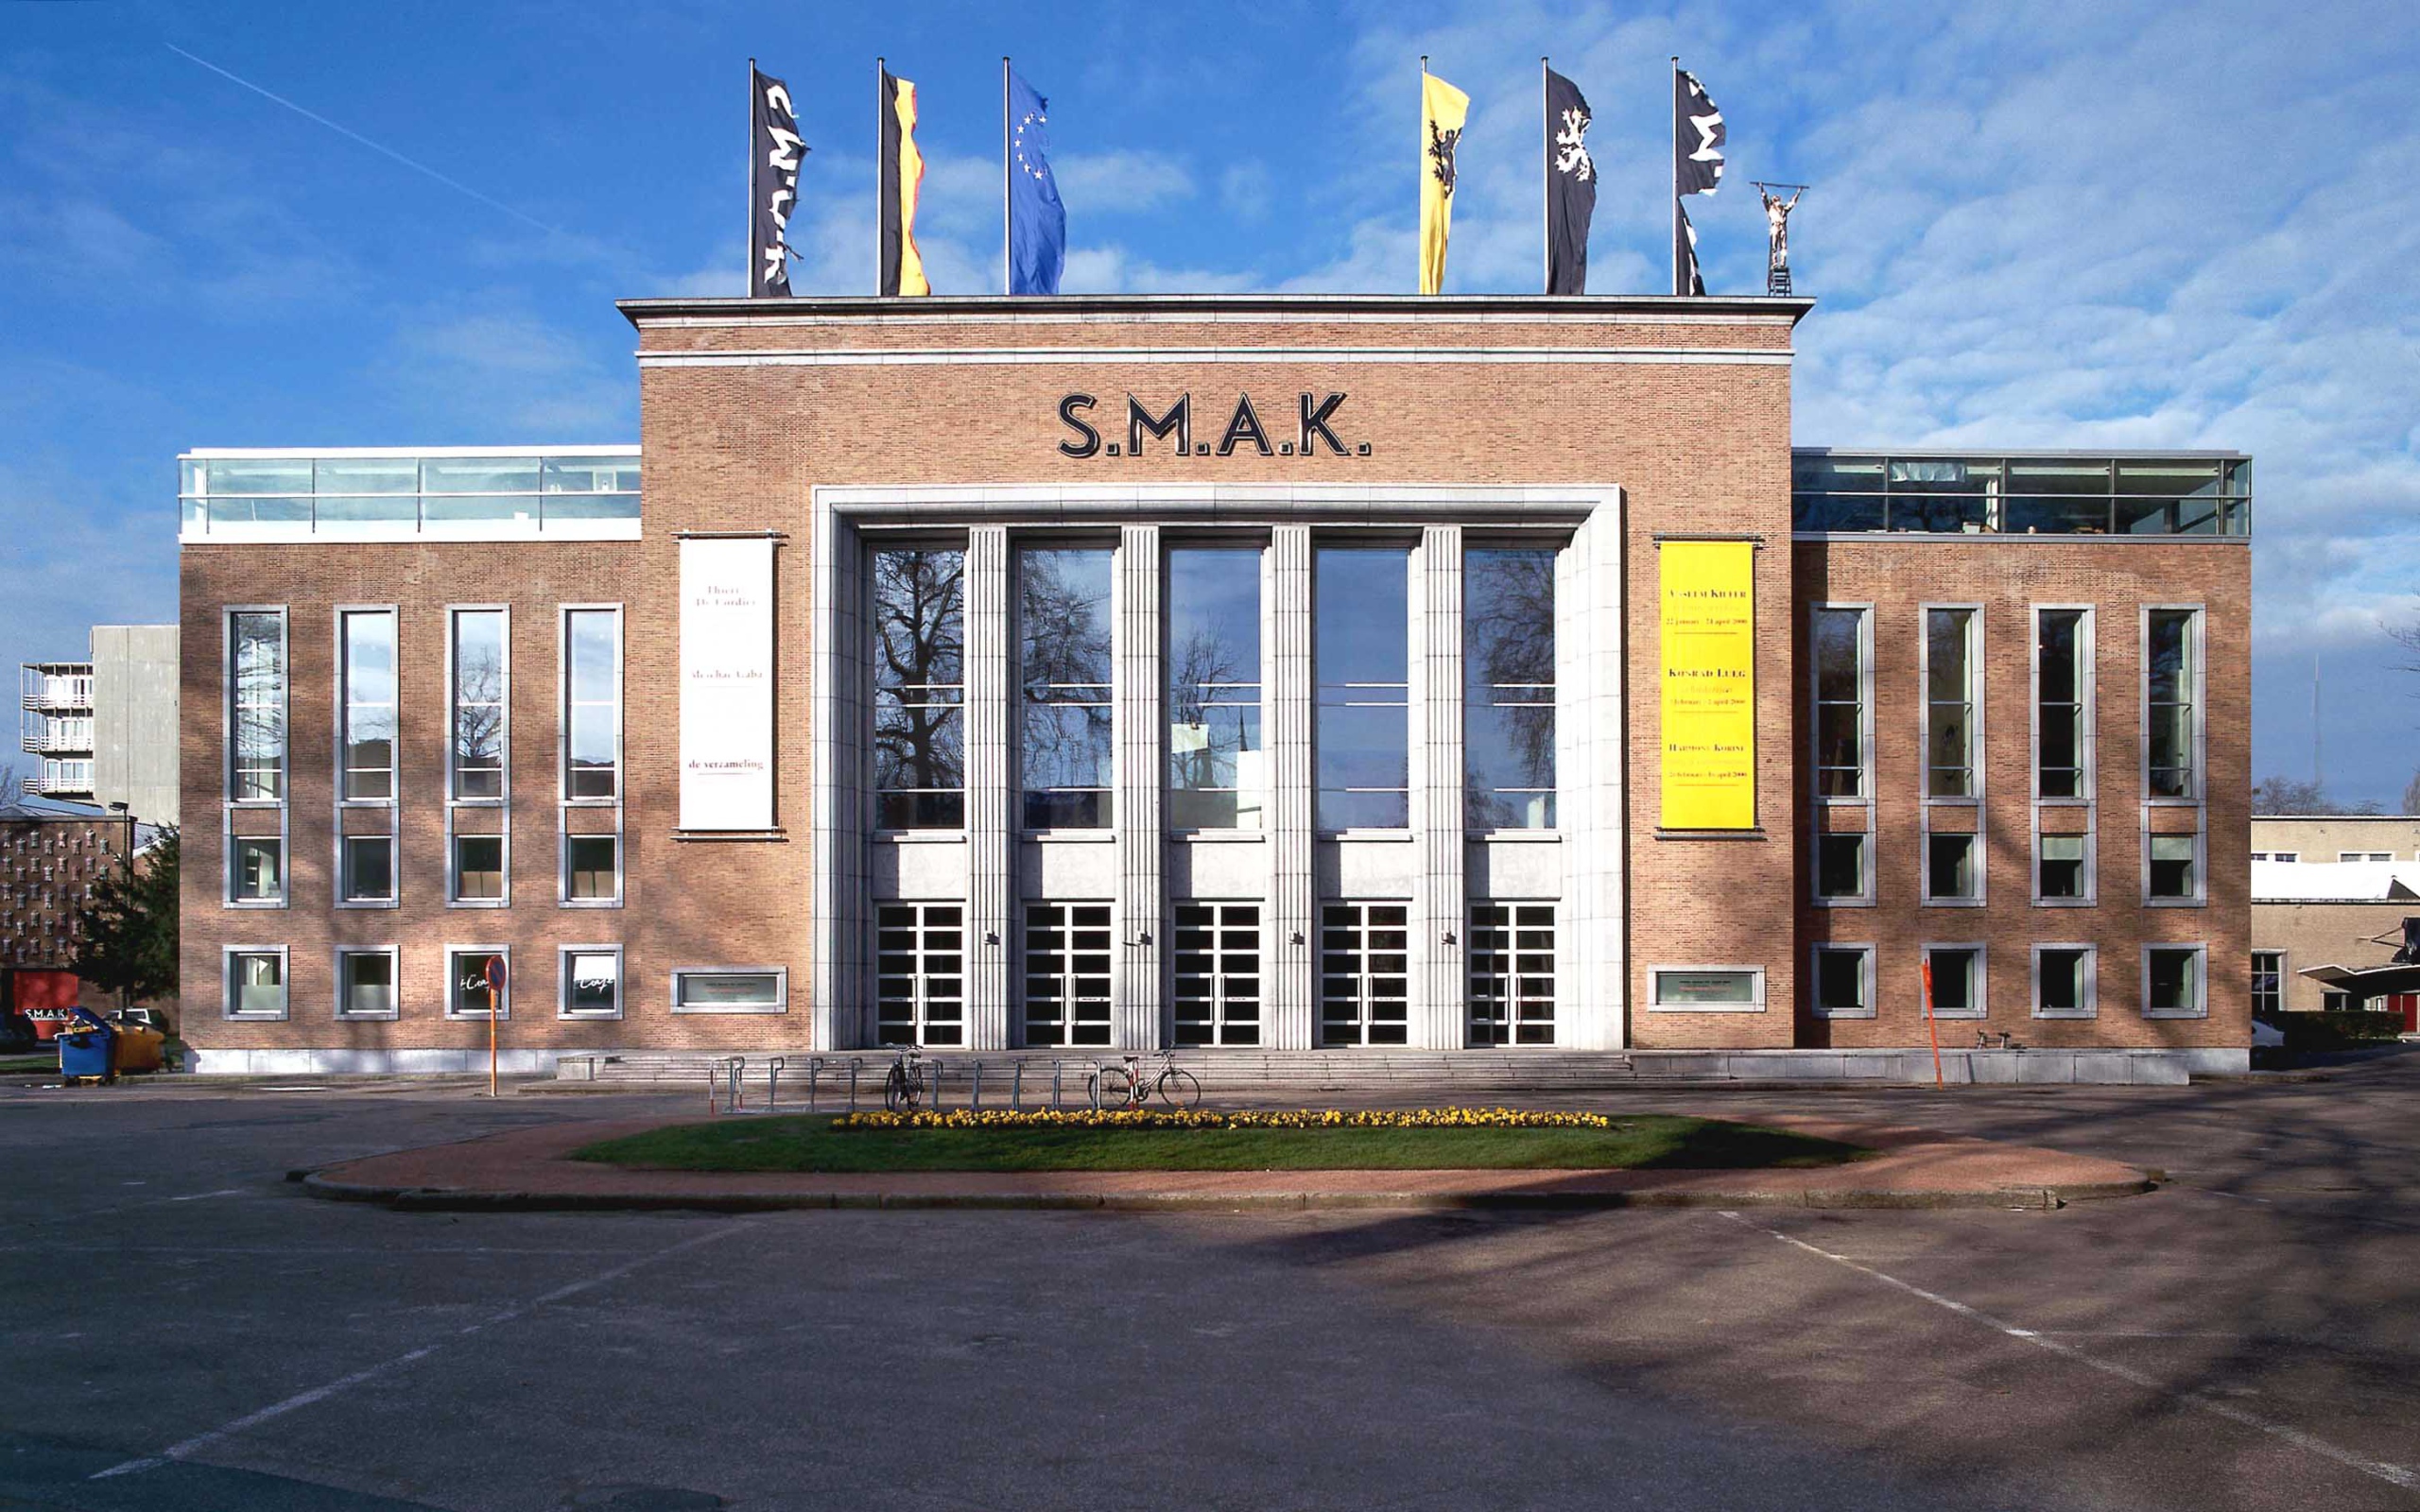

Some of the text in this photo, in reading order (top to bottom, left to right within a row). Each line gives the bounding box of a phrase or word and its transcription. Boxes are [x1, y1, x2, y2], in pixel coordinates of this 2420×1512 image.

[1056, 391, 1372, 458] S.M.A.K.
[688, 758, 764, 771] de verzameling
